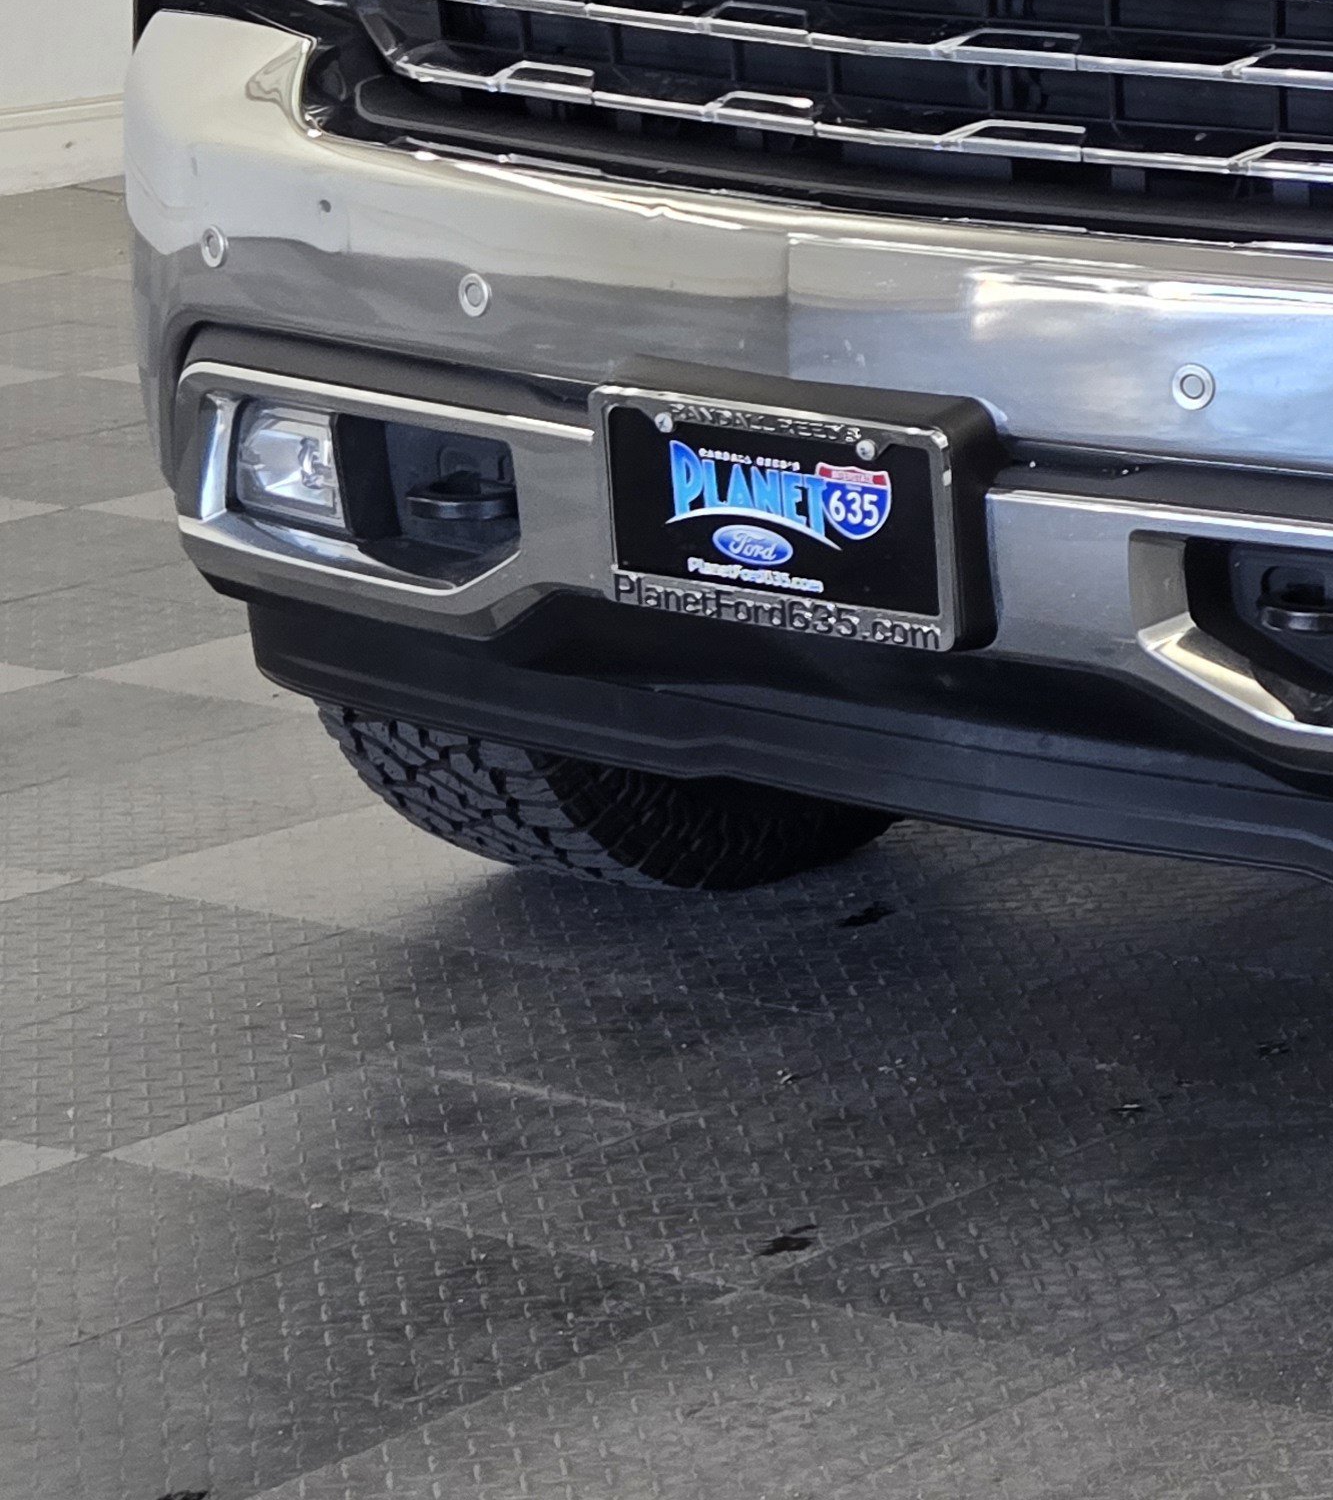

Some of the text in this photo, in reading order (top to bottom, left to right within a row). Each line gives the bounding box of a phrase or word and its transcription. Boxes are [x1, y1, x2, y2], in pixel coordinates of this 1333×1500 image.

[669, 440, 828, 537] PLANET
[829, 489, 879, 527] 635
[729, 529, 778, 562] Ford
[613, 572, 941, 650] PlanetFord635.com
